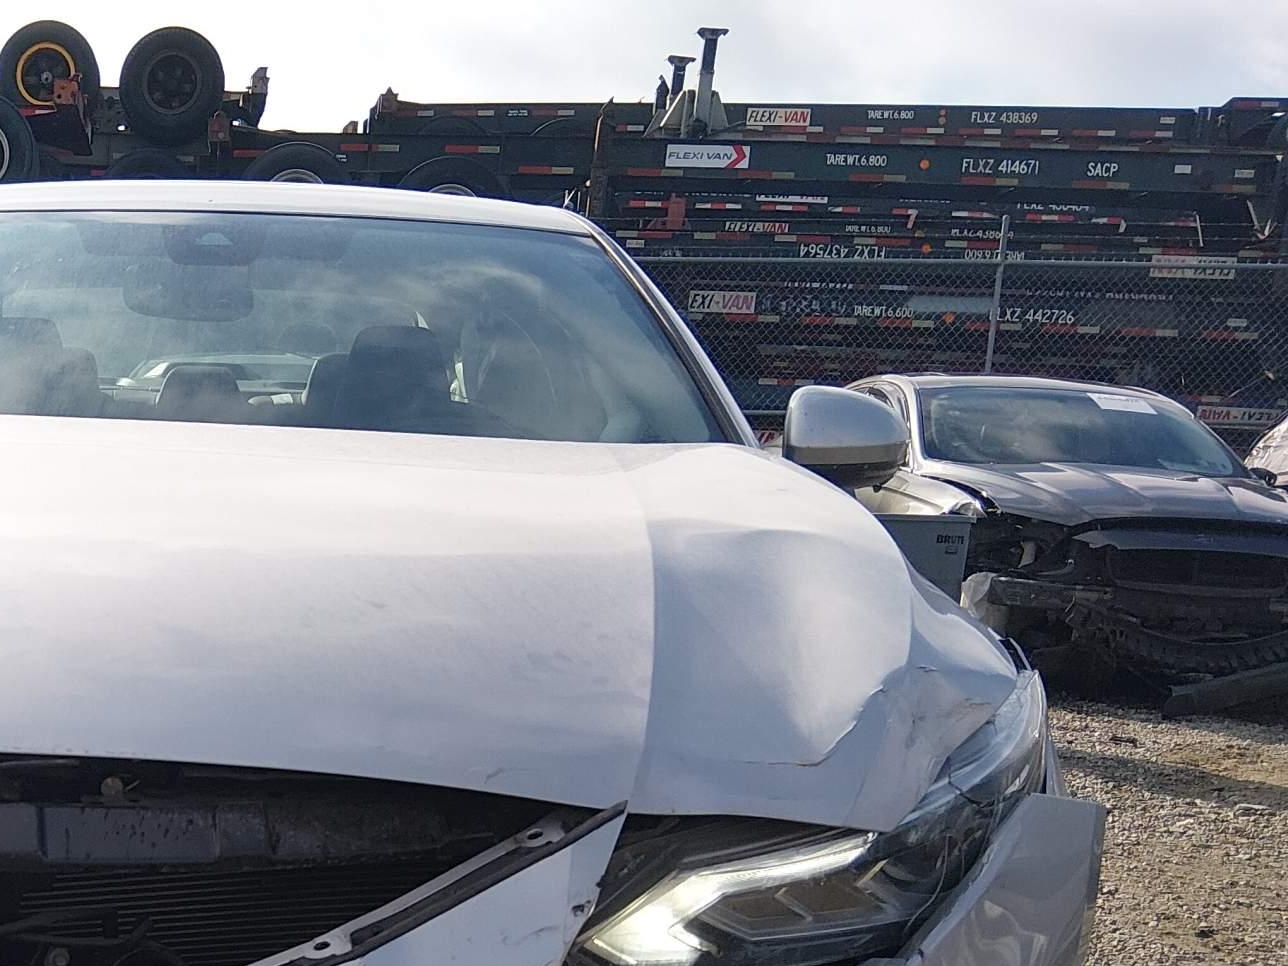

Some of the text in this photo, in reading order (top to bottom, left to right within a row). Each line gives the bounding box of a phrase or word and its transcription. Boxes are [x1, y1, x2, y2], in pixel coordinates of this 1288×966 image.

[748, 109, 810, 124] FLEXI-VAN
[867, 110, 883, 119] TARE
[971, 112, 1038, 124] FLXZ 438369
[668, 152, 733, 160] FLEXI VAN
[826, 154, 846, 165] TARE
[861, 155, 887, 166] 6.800
[962, 159, 1039, 174] FLXZ 414671
[1087, 162, 1118, 176] SACP
[800, 243, 886, 259] FLXZ 437564
[854, 306, 873, 317] TARE
[1025, 308, 1074, 324] 442726
